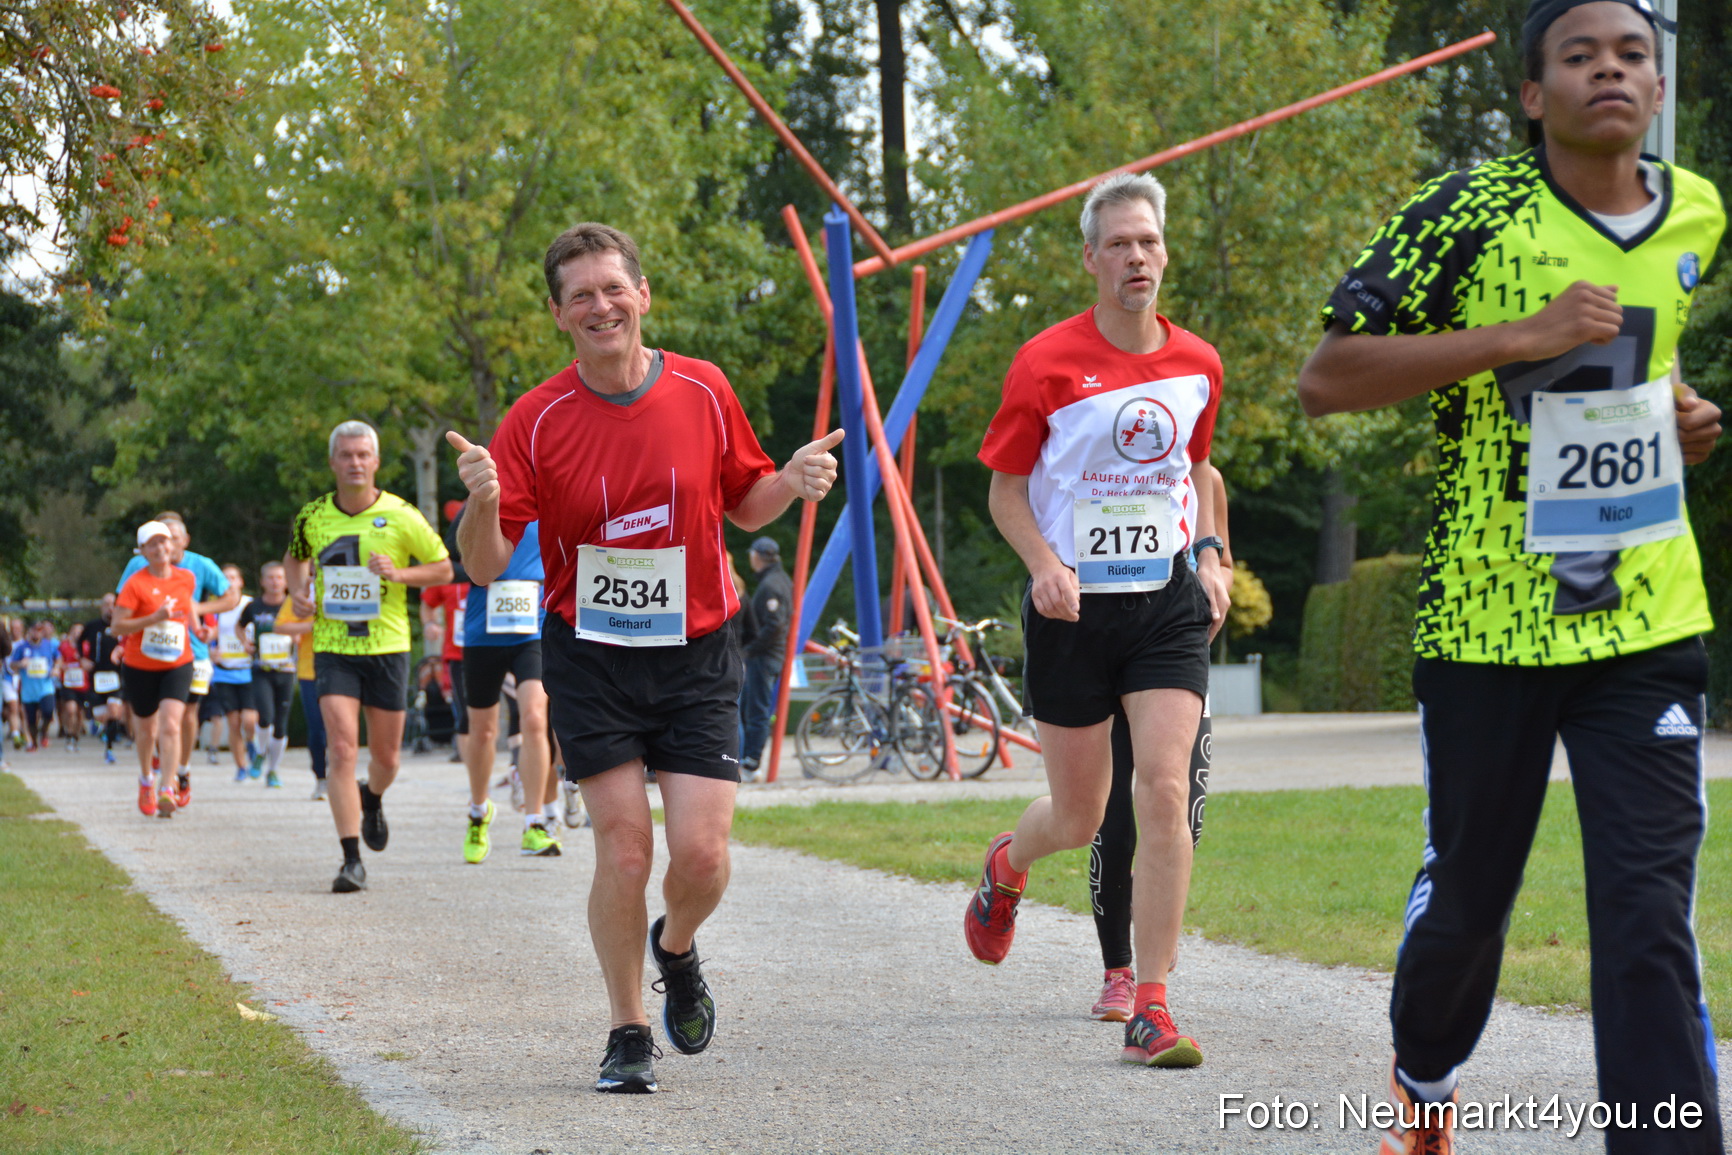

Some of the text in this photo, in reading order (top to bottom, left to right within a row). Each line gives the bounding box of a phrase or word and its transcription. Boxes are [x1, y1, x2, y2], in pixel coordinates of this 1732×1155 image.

[1601, 400, 1649, 419] BOCK
[1557, 431, 1661, 489] 2681
[1082, 470, 1181, 487] LAUFEN MIT HER
[1091, 488, 1105, 497] Dr.
[1107, 489, 1128, 497] Heck
[1112, 504, 1146, 513] BOCK
[1599, 505, 1633, 522] Nico
[623, 515, 652, 531] DEHN
[1089, 525, 1159, 555] 2173
[617, 557, 655, 567] BOCK
[1107, 565, 1146, 577] Rüdiger
[331, 583, 371, 600] 2675
[592, 574, 669, 609] 2534
[495, 597, 531, 613] 2585
[608, 616, 652, 630] Gerhard
[150, 631, 178, 646] 2564
[1655, 724, 1699, 736] adidas
